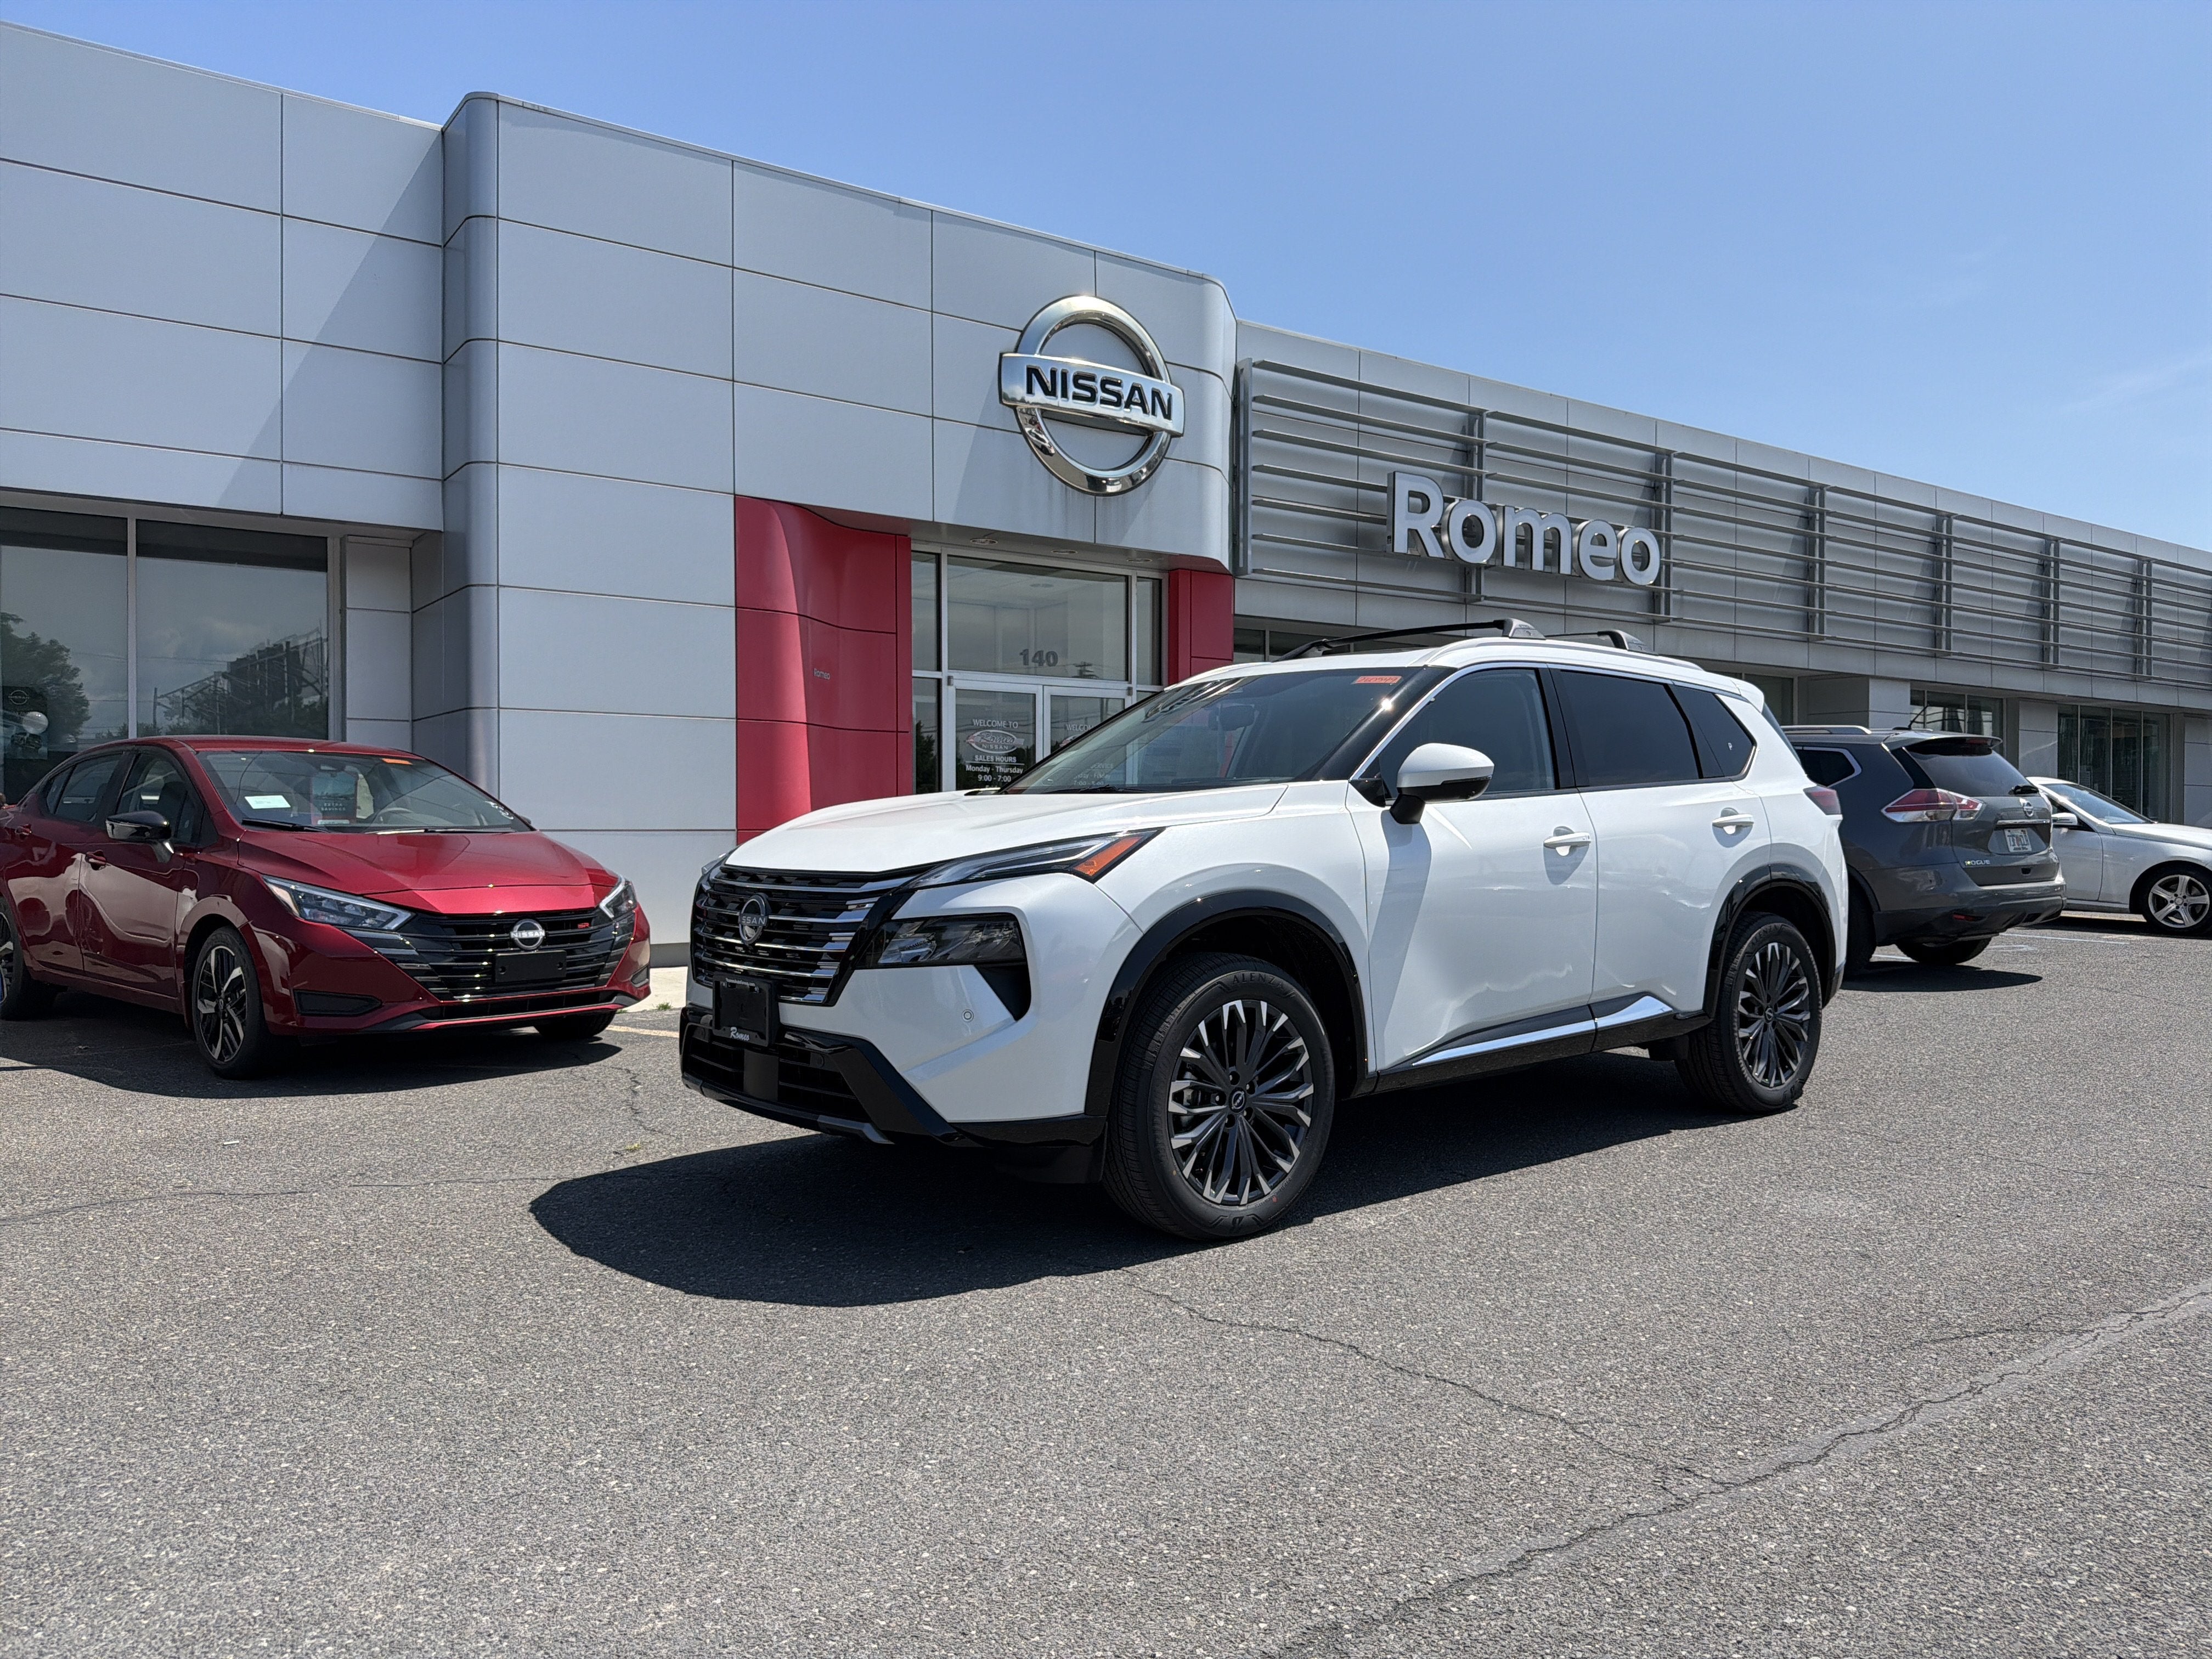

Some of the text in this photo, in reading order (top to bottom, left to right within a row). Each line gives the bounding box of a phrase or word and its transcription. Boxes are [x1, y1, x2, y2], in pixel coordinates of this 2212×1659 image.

[1025, 364, 1173, 421] NISSAN
[1389, 471, 1660, 586] Romeo
[1019, 648, 1058, 667] 140
[973, 719, 1007, 729] WELCOME
[966, 764, 990, 774] Monday
[995, 765, 1024, 774] Thursday
[510, 930, 545, 939] NISSAN
[730, 1026, 750, 1041] Romeo
